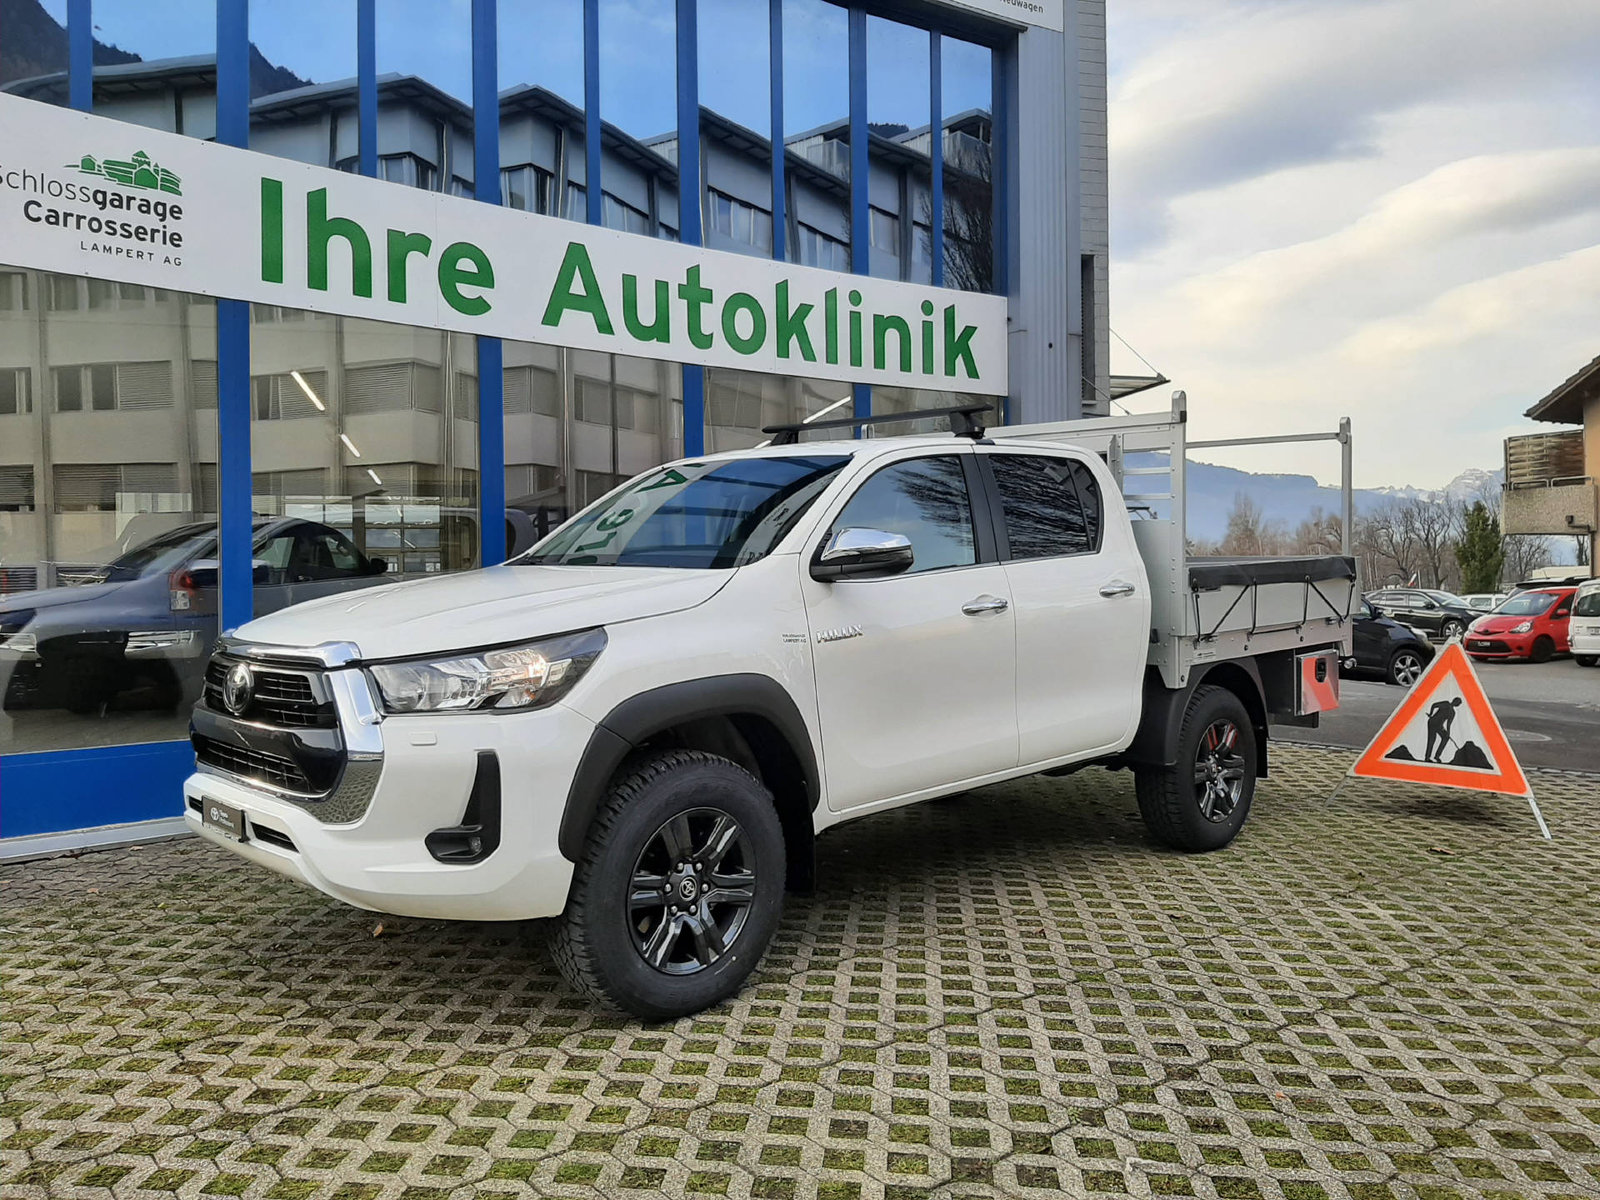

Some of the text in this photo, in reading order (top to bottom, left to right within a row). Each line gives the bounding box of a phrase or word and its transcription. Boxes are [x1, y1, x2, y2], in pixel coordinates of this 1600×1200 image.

[1002, 0, 1043, 13] euwagen
[0, 165, 183, 222] chlossgarage
[24, 200, 183, 248] Carrosserie
[81, 241, 182, 267] LAMPERT AG
[261, 177, 980, 380] Ihre Autoklinik
